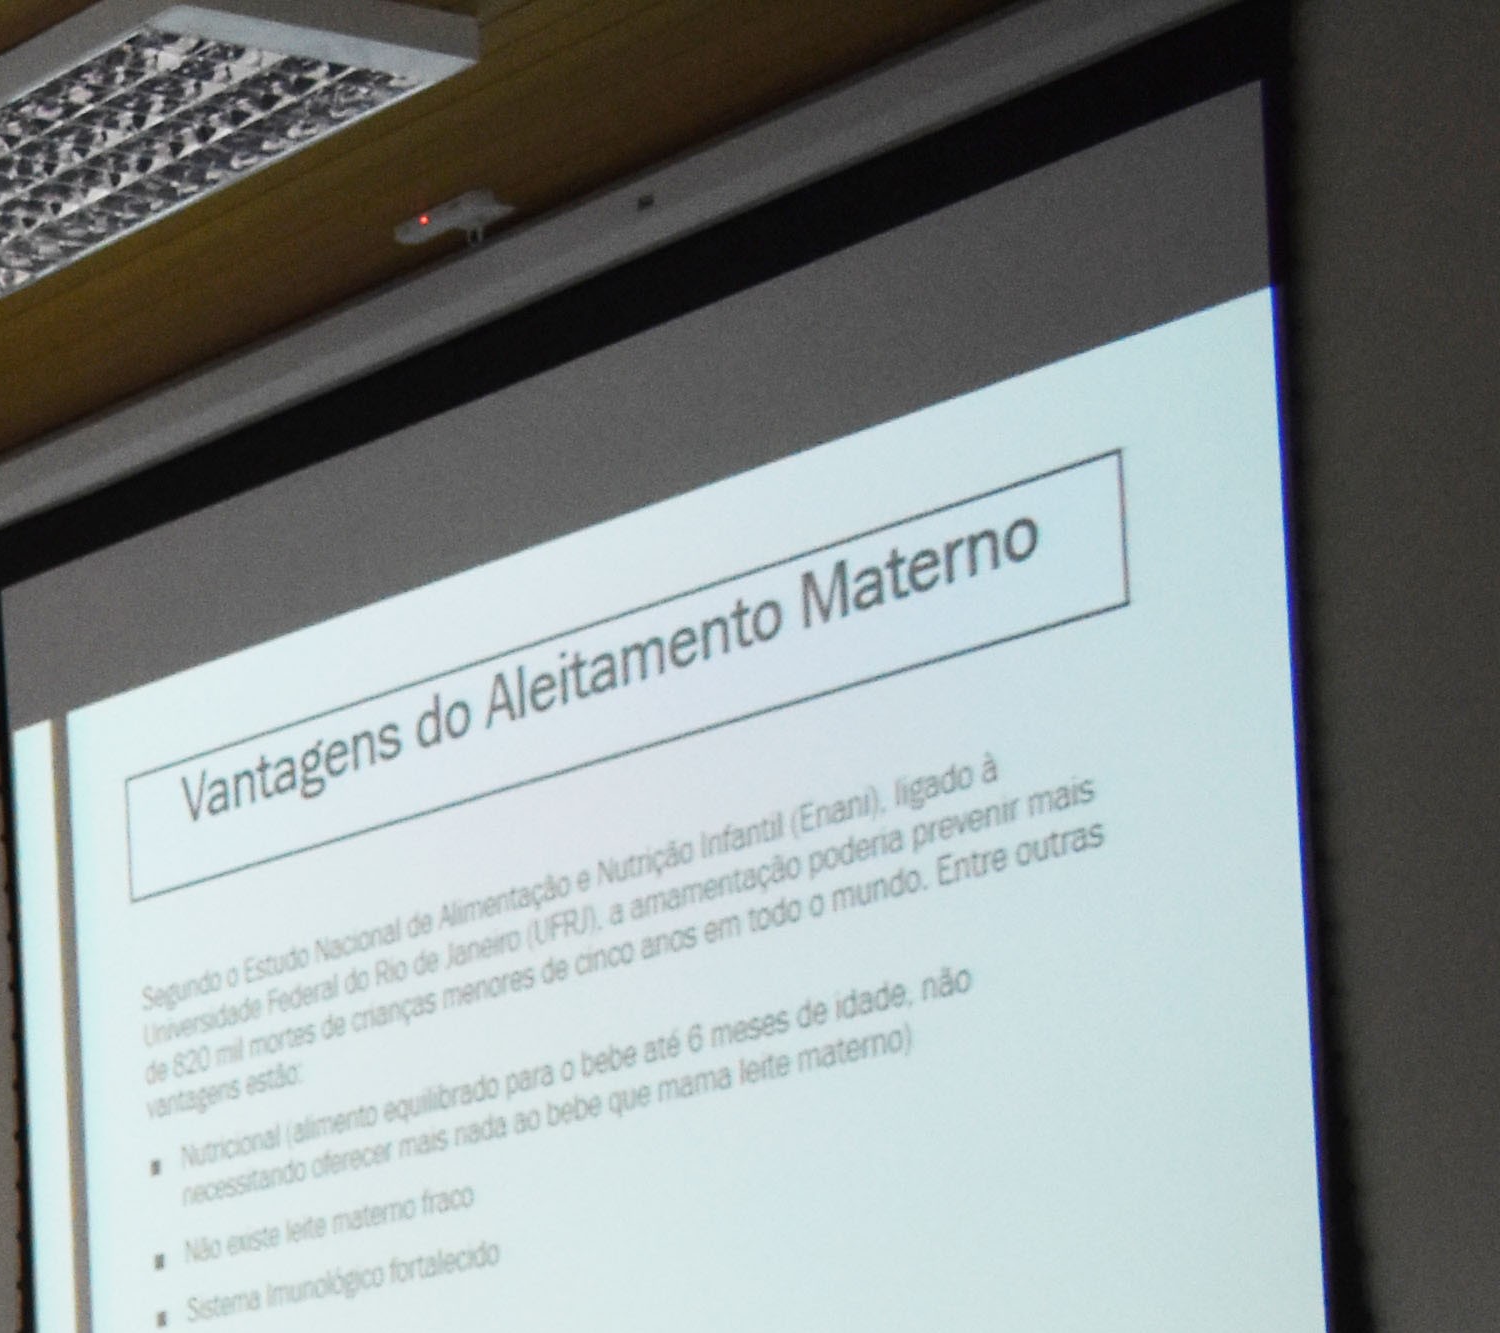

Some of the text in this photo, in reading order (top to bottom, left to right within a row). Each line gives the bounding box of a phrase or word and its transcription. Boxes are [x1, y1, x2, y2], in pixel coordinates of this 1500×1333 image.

[179, 515, 1040, 823] Vantagens do Aleitamento Materno
